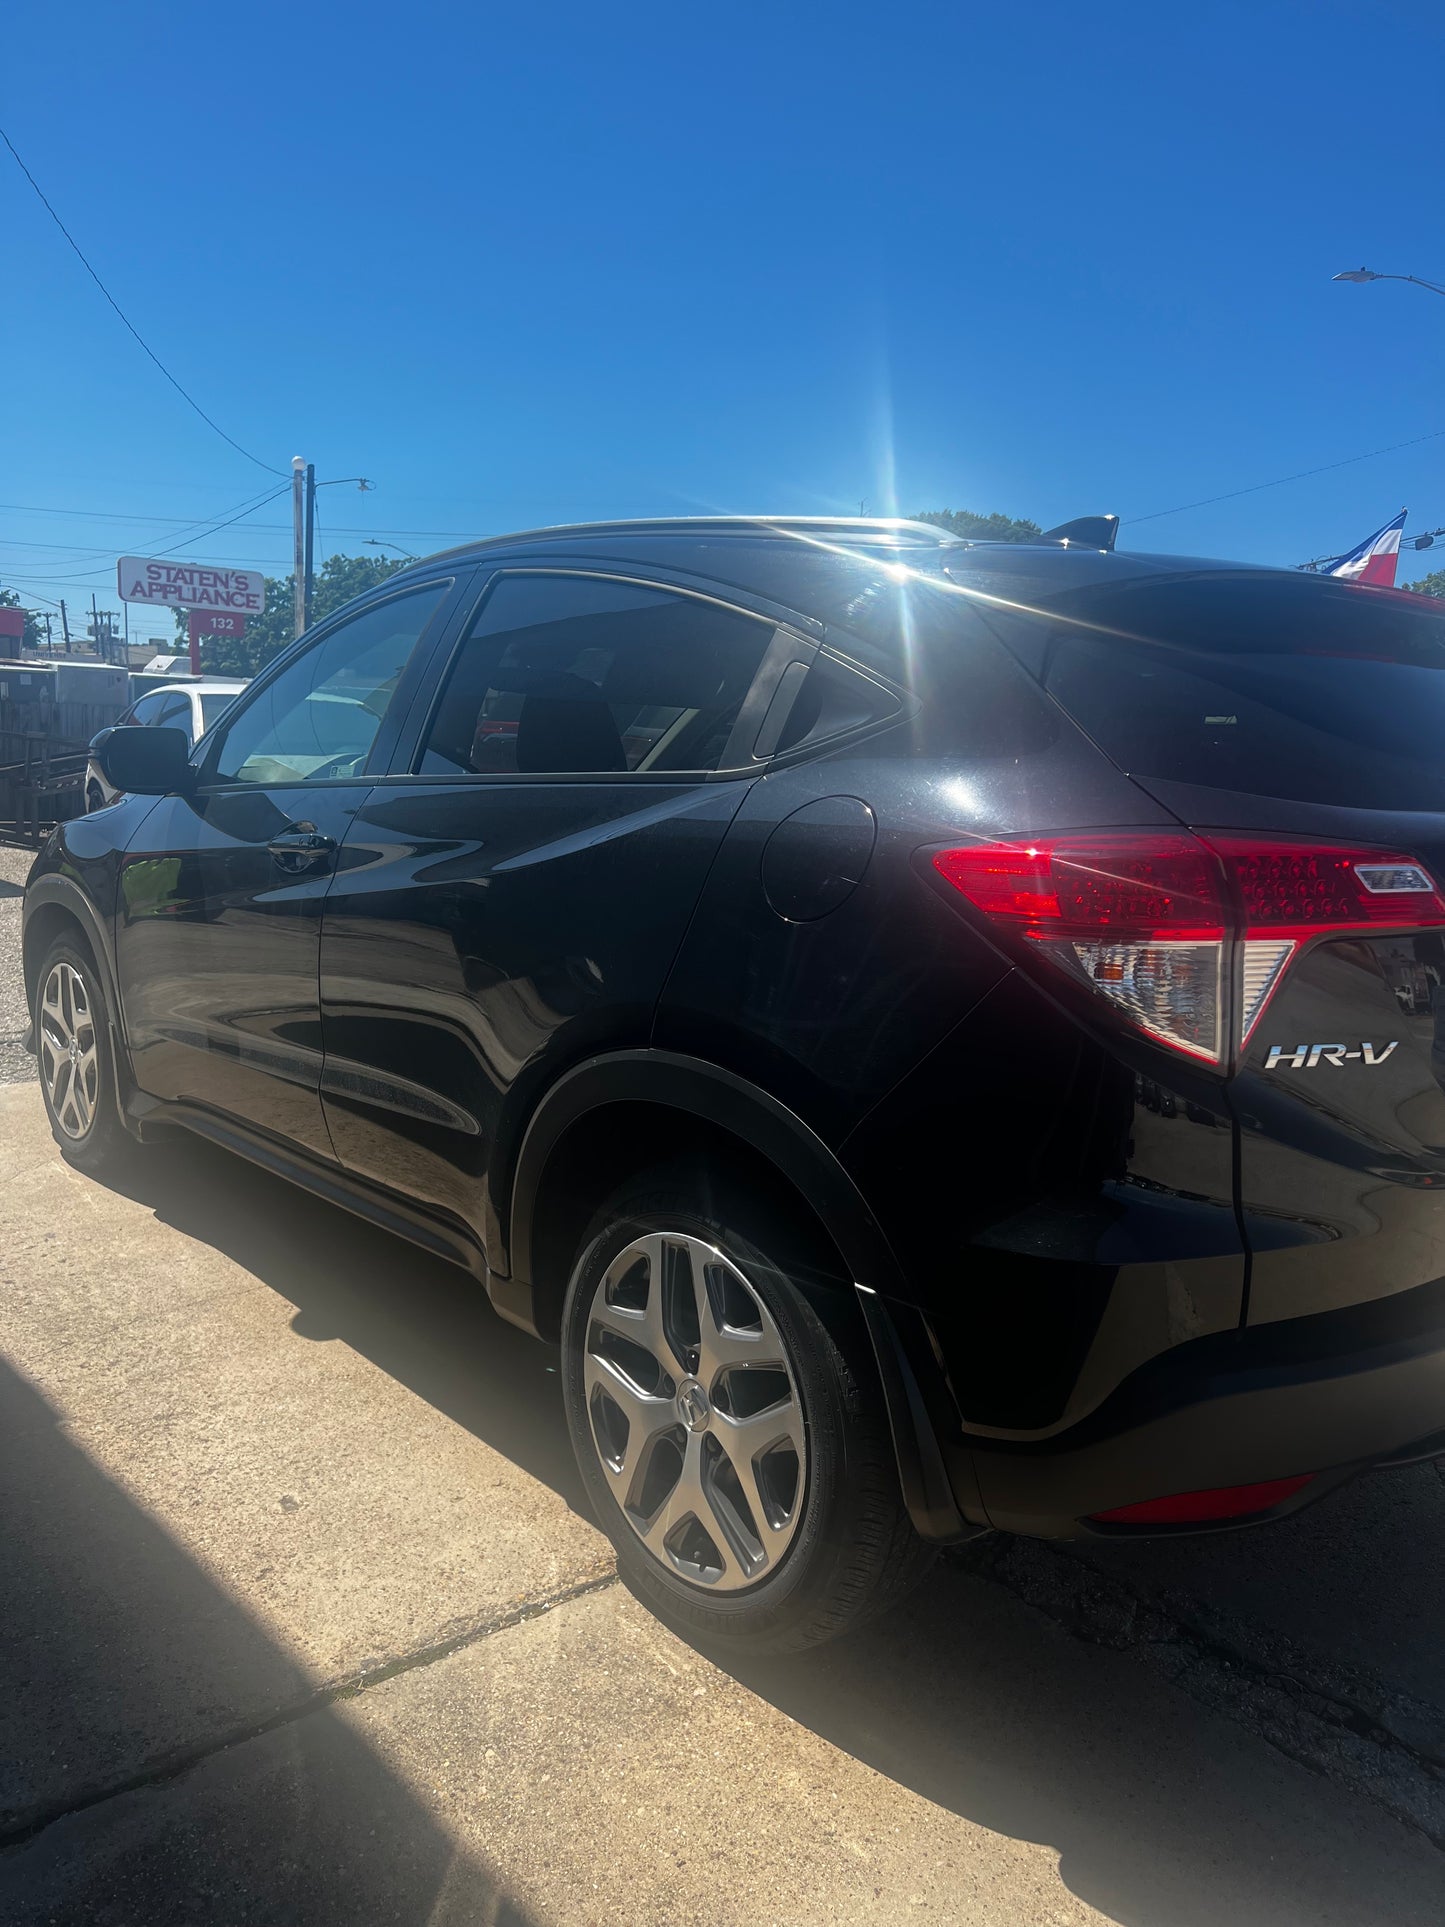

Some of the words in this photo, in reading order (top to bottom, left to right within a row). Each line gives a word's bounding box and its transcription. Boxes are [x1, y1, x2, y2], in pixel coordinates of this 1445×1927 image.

[147, 564, 249, 591] STATEN'S
[130, 581, 260, 610] APPLIANCE
[210, 618, 234, 630] 132
[1265, 1041, 1399, 1069] HR-V
